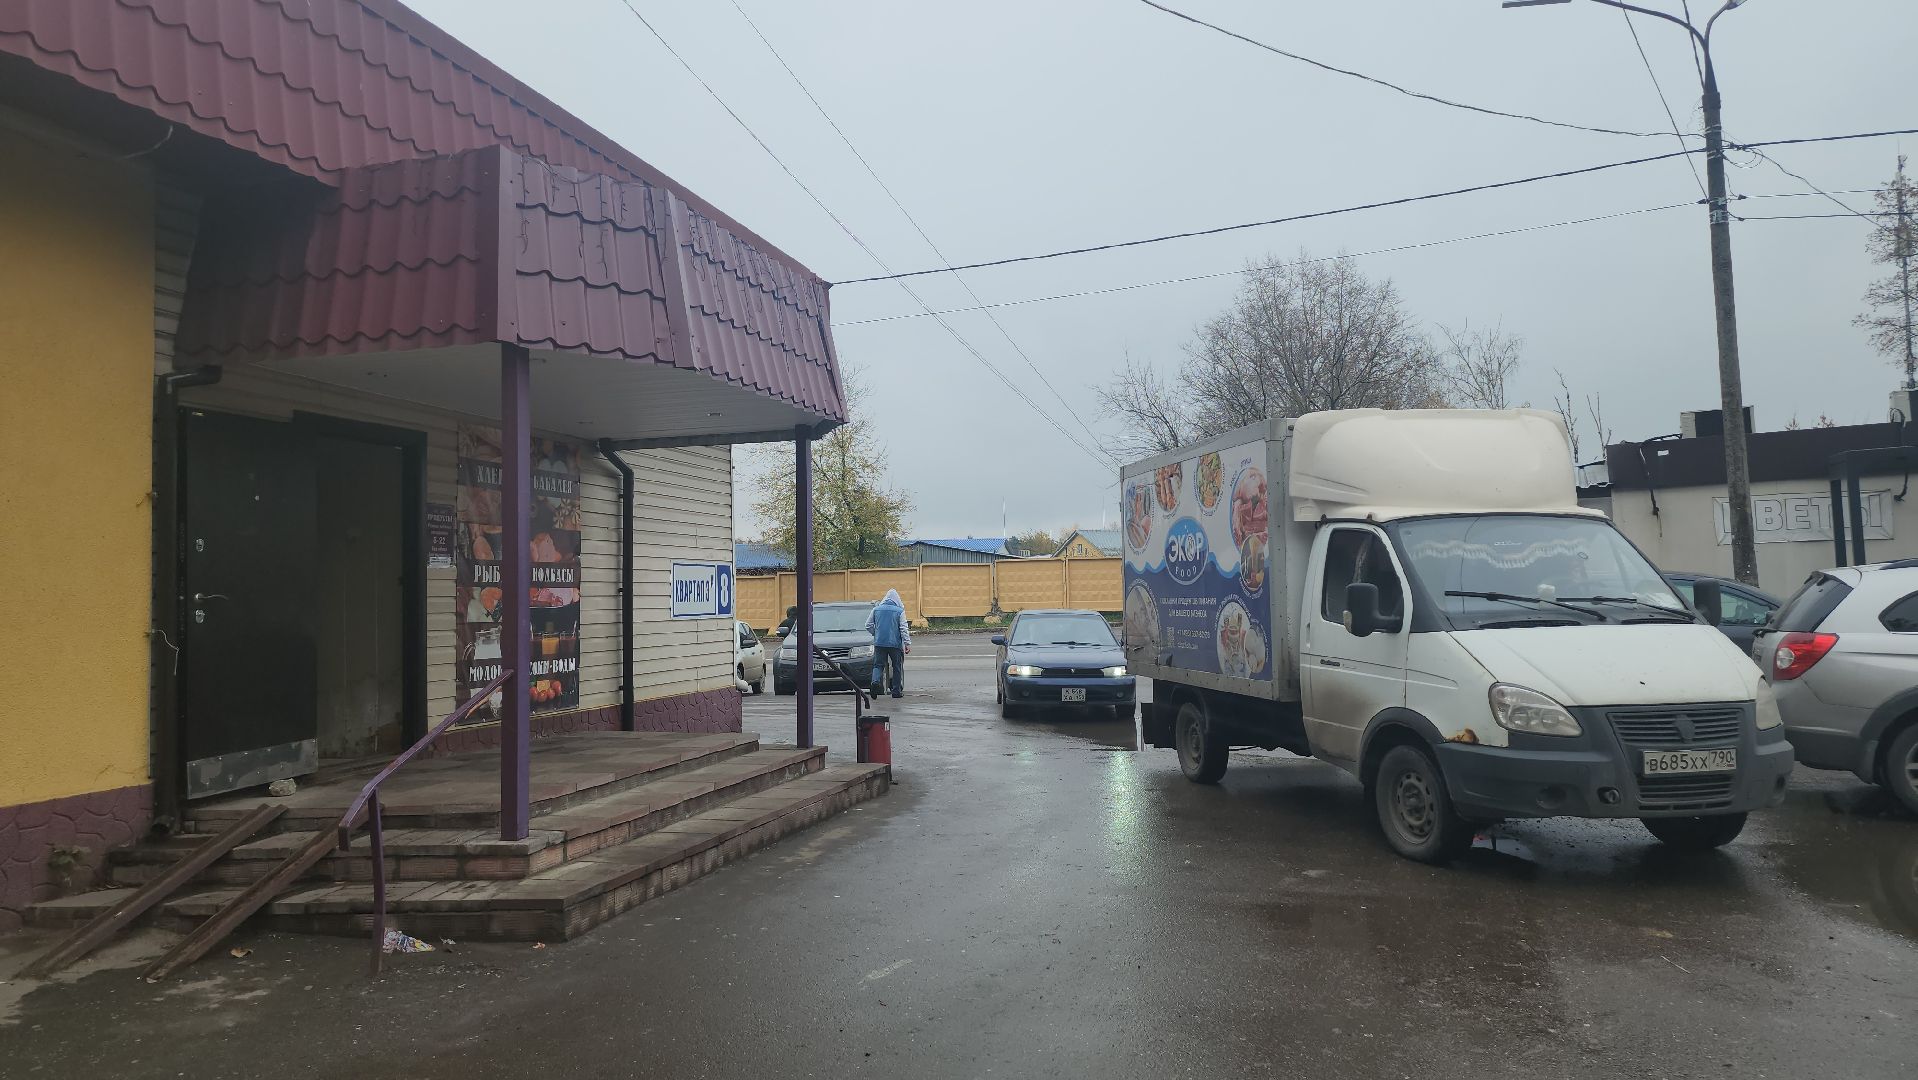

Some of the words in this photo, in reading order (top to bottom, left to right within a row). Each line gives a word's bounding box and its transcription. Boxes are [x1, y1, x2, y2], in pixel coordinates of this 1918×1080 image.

[474, 564, 501, 583] РЫБ
[532, 567, 574, 583] КОЛБАСЫ
[1175, 565, 1197, 577] FOOD
[675, 579, 705, 603] КВАРТАЛ
[720, 573, 729, 608] 8
[1649, 753, 1708, 772] В685ХХ
[1711, 750, 1734, 764] 790
